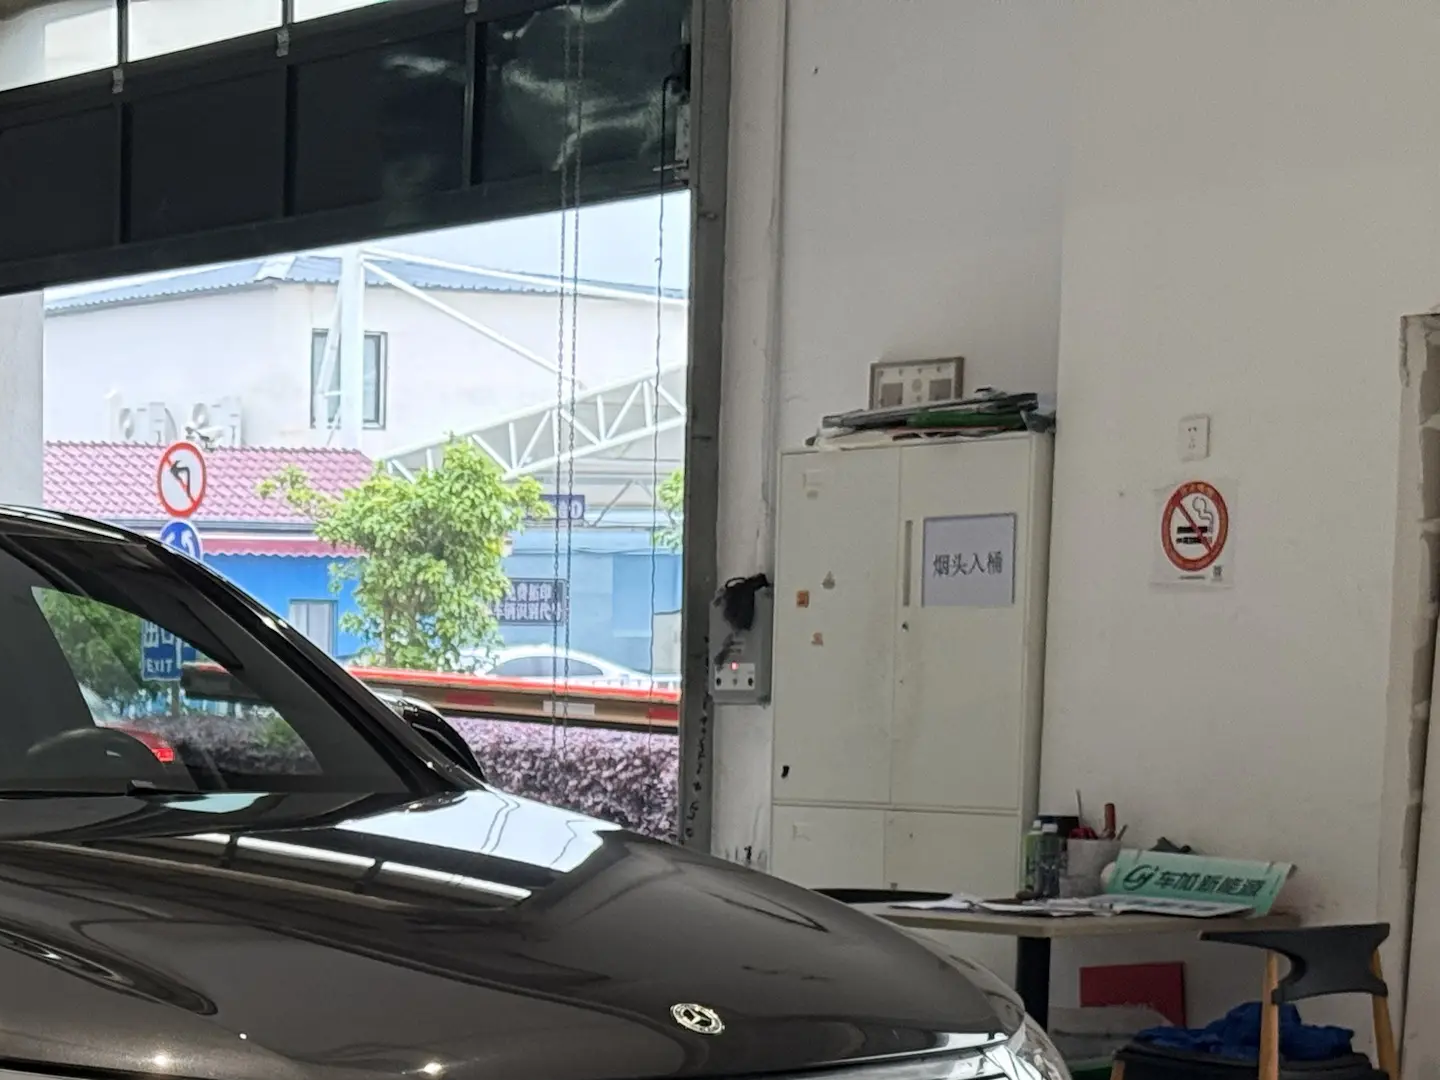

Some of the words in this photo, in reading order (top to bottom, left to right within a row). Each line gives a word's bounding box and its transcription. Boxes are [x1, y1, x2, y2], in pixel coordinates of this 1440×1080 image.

[933, 551, 1003, 577] 烟头入桶
[146, 658, 173, 673] EXIT
[1155, 871, 1266, 896] 车加新能源
